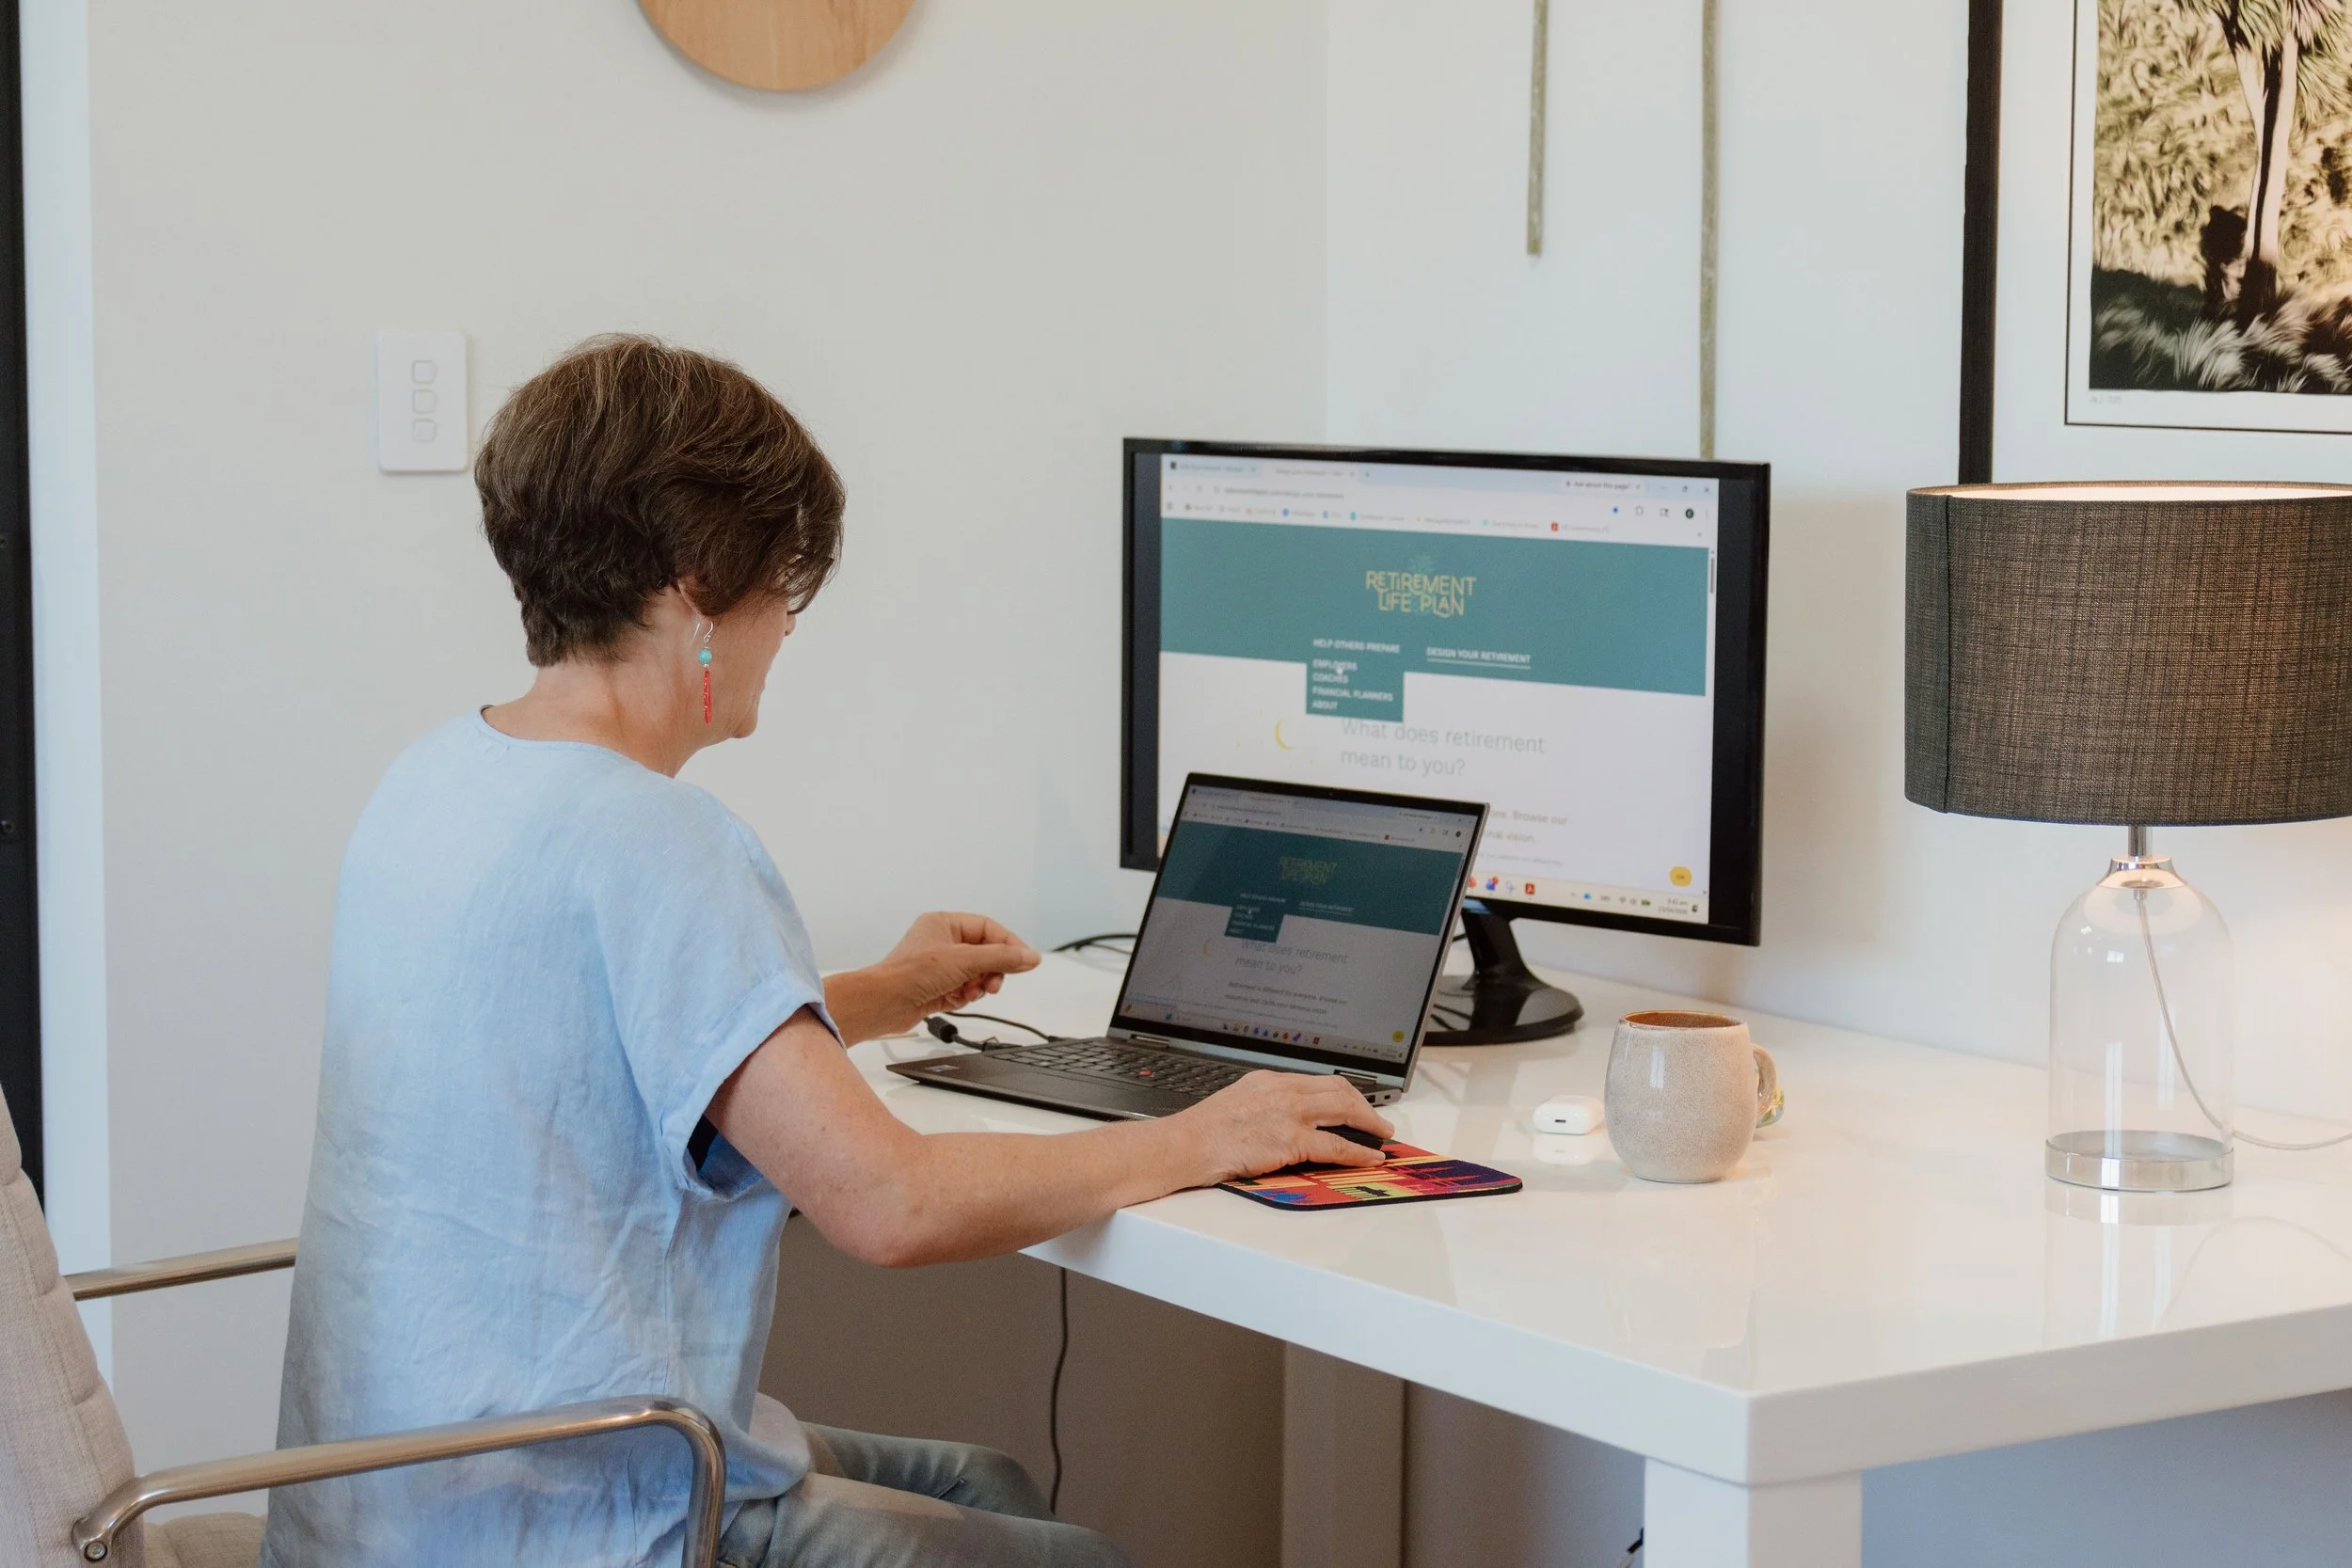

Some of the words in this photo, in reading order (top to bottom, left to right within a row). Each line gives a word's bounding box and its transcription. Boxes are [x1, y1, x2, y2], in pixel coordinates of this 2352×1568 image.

[1365, 570, 1477, 596] RETIREMENT
[1378, 591, 1412, 612] LIFE
[1420, 594, 1465, 618] PLAN
[1312, 639, 1333, 649] HELP
[1334, 640, 1365, 651] OTHERS
[1366, 641, 1400, 654] PREPARE
[1426, 646, 1456, 657] DESIGN
[1457, 649, 1479, 659] YOUR
[1481, 651, 1532, 663] RETIREMENT
[1312, 673, 1349, 685] COACHES
[1311, 687, 1351, 699] FINANCIAL
[1353, 689, 1394, 703] PLANNERS
[1311, 700, 1338, 711] ABOUT
[1343, 719, 1389, 740] What
[1394, 724, 1439, 745] does
[1445, 730, 1547, 754] retirement
[1341, 751, 1391, 770] mean
[1398, 753, 1417, 772] to
[1422, 758, 1466, 778] you?
[1513, 810, 1549, 824] Browse
[1550, 815, 1568, 826] our
[1242, 939, 1266, 953] What
[1269, 943, 1293, 957] does
[1295, 947, 1349, 964] retirement
[1234, 957, 1263, 970] mean
[1265, 959, 1278, 972] to
[1279, 962, 1303, 975] you?
